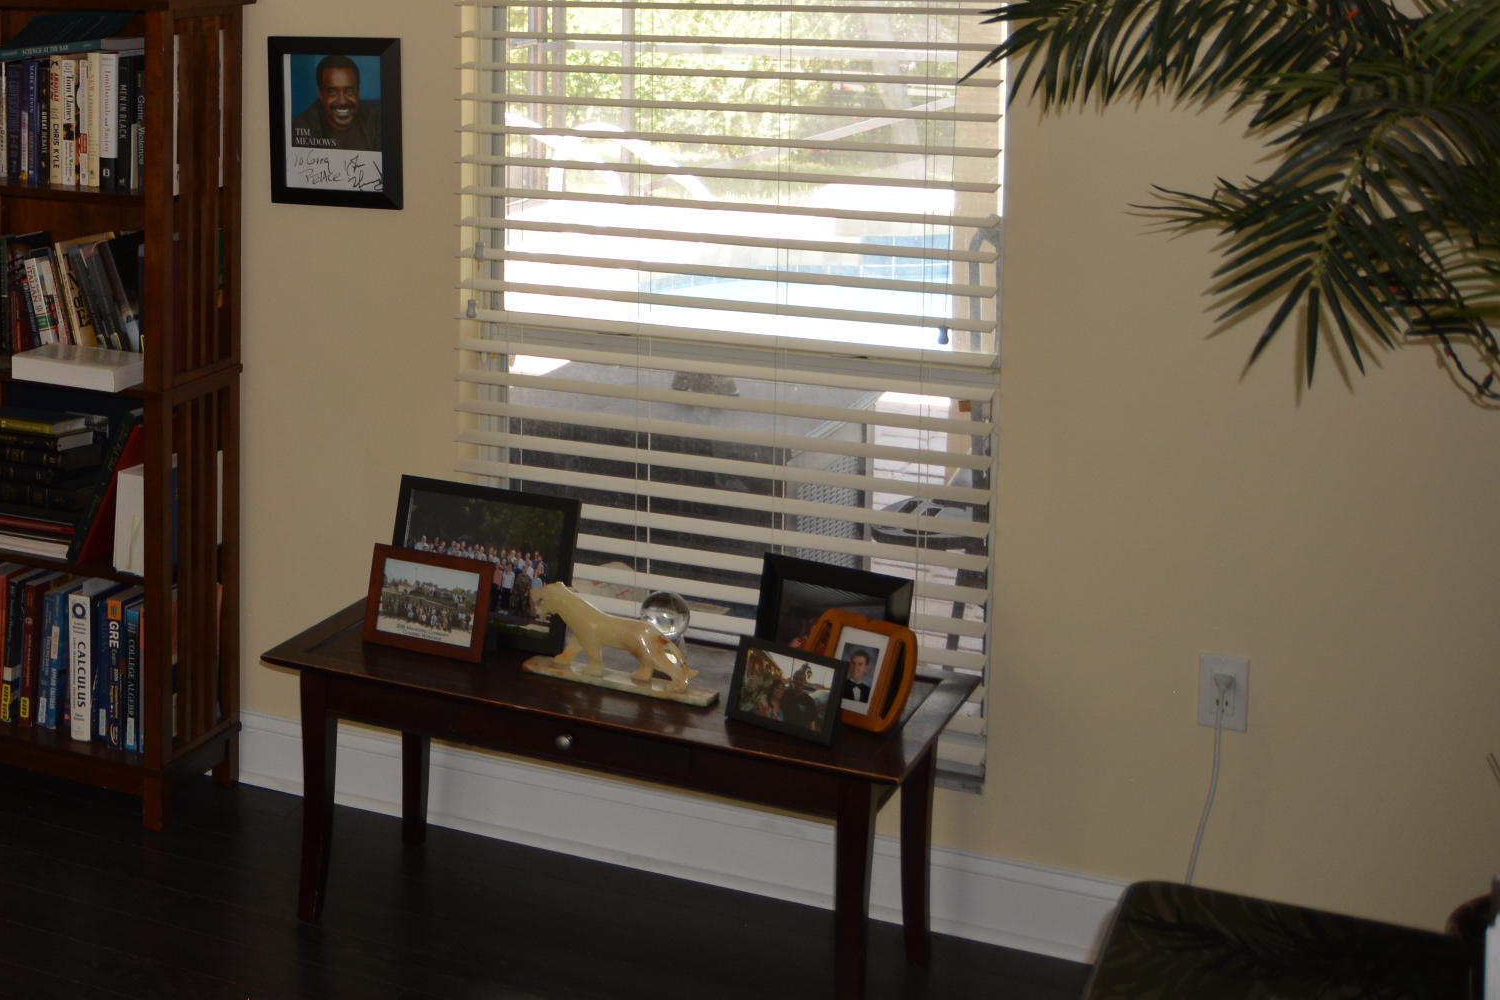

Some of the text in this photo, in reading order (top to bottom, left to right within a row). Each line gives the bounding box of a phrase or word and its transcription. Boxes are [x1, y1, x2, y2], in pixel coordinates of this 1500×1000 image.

[66, 75, 74, 121] Tom Clancy
[119, 84, 127, 139] MEN IN BLACK
[137, 96, 146, 120] Guns
[294, 127, 337, 147] TIM MEADOWS
[27, 266, 38, 303] ITALIAN
[109, 621, 120, 649] GRE
[78, 641, 86, 708] CALCULUS
